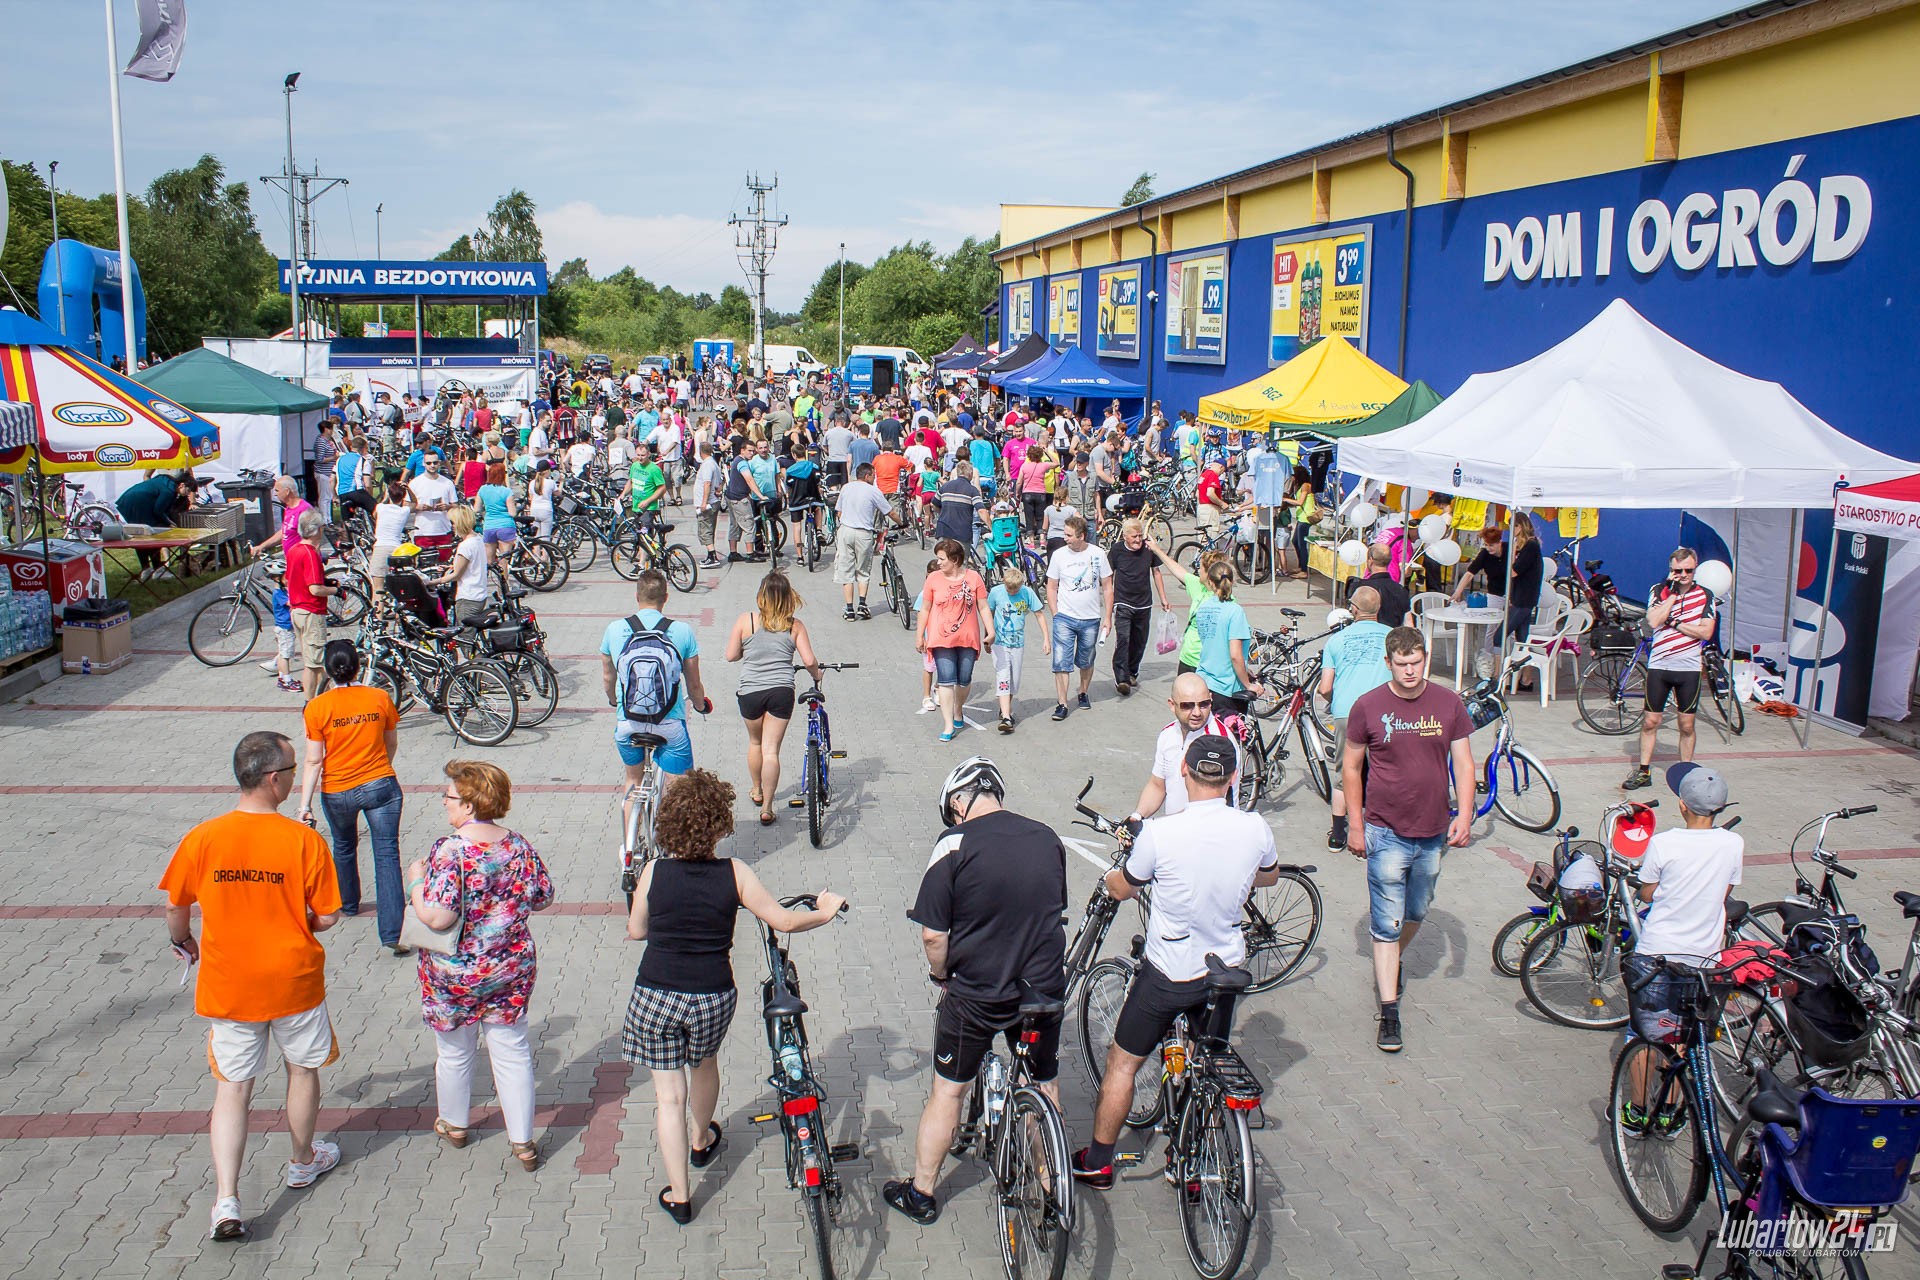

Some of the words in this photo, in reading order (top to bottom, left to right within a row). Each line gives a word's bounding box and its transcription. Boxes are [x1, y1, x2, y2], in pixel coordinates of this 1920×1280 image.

[1484, 211, 1582, 282] DOM
[1596, 207, 1614, 276] I
[1627, 154, 1872, 274] OGRÓD
[1279, 254, 1292, 273] HIT
[374, 269, 537, 287] BEZDOTYKOWA
[1334, 290, 1360, 301] BIOHUMUS
[1340, 302, 1359, 316] NAWÓZ
[1330, 321, 1358, 332] NATURALNY
[381, 356, 413, 365] MRÓWKA
[501, 356, 532, 365] MRÓWKA
[66, 407, 121, 424] koral
[67, 452, 87, 462] lody
[101, 450, 131, 463] koral
[141, 449, 160, 460] lody
[1839, 504, 1906, 526] STAROSTWO
[1844, 563, 1855, 572] Bank
[333, 712, 380, 728] ORGANIZATOR
[1392, 714, 1442, 730] Honolulu
[213, 869, 285, 885] ORGANIZATOR
